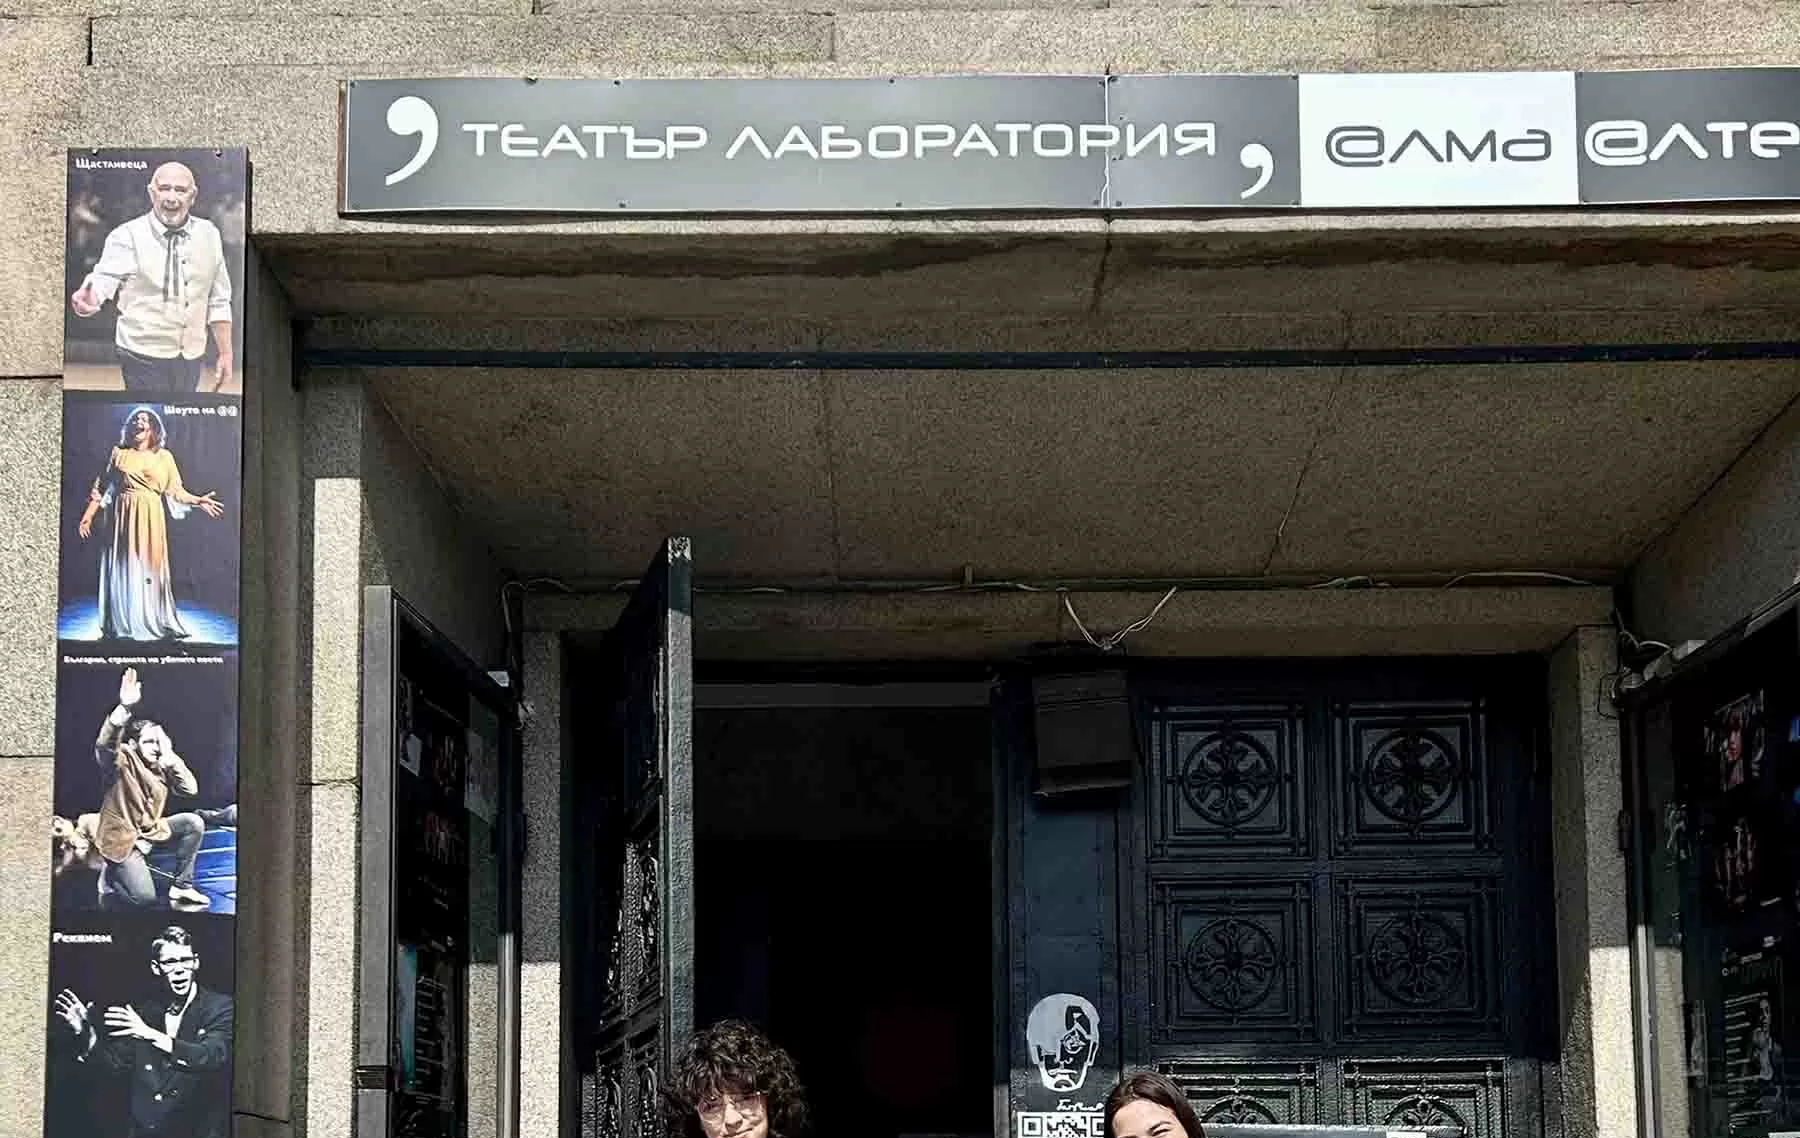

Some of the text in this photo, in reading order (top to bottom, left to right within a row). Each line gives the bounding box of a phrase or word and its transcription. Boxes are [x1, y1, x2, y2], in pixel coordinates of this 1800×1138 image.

[462, 120, 1217, 161] ТЕАТЪР ЛАБОРАТОРИЯ
[75, 157, 149, 171] Щастливеца
[163, 404, 200, 417] Шоуто
[201, 406, 216, 416] на
[52, 931, 113, 944] Реквием
